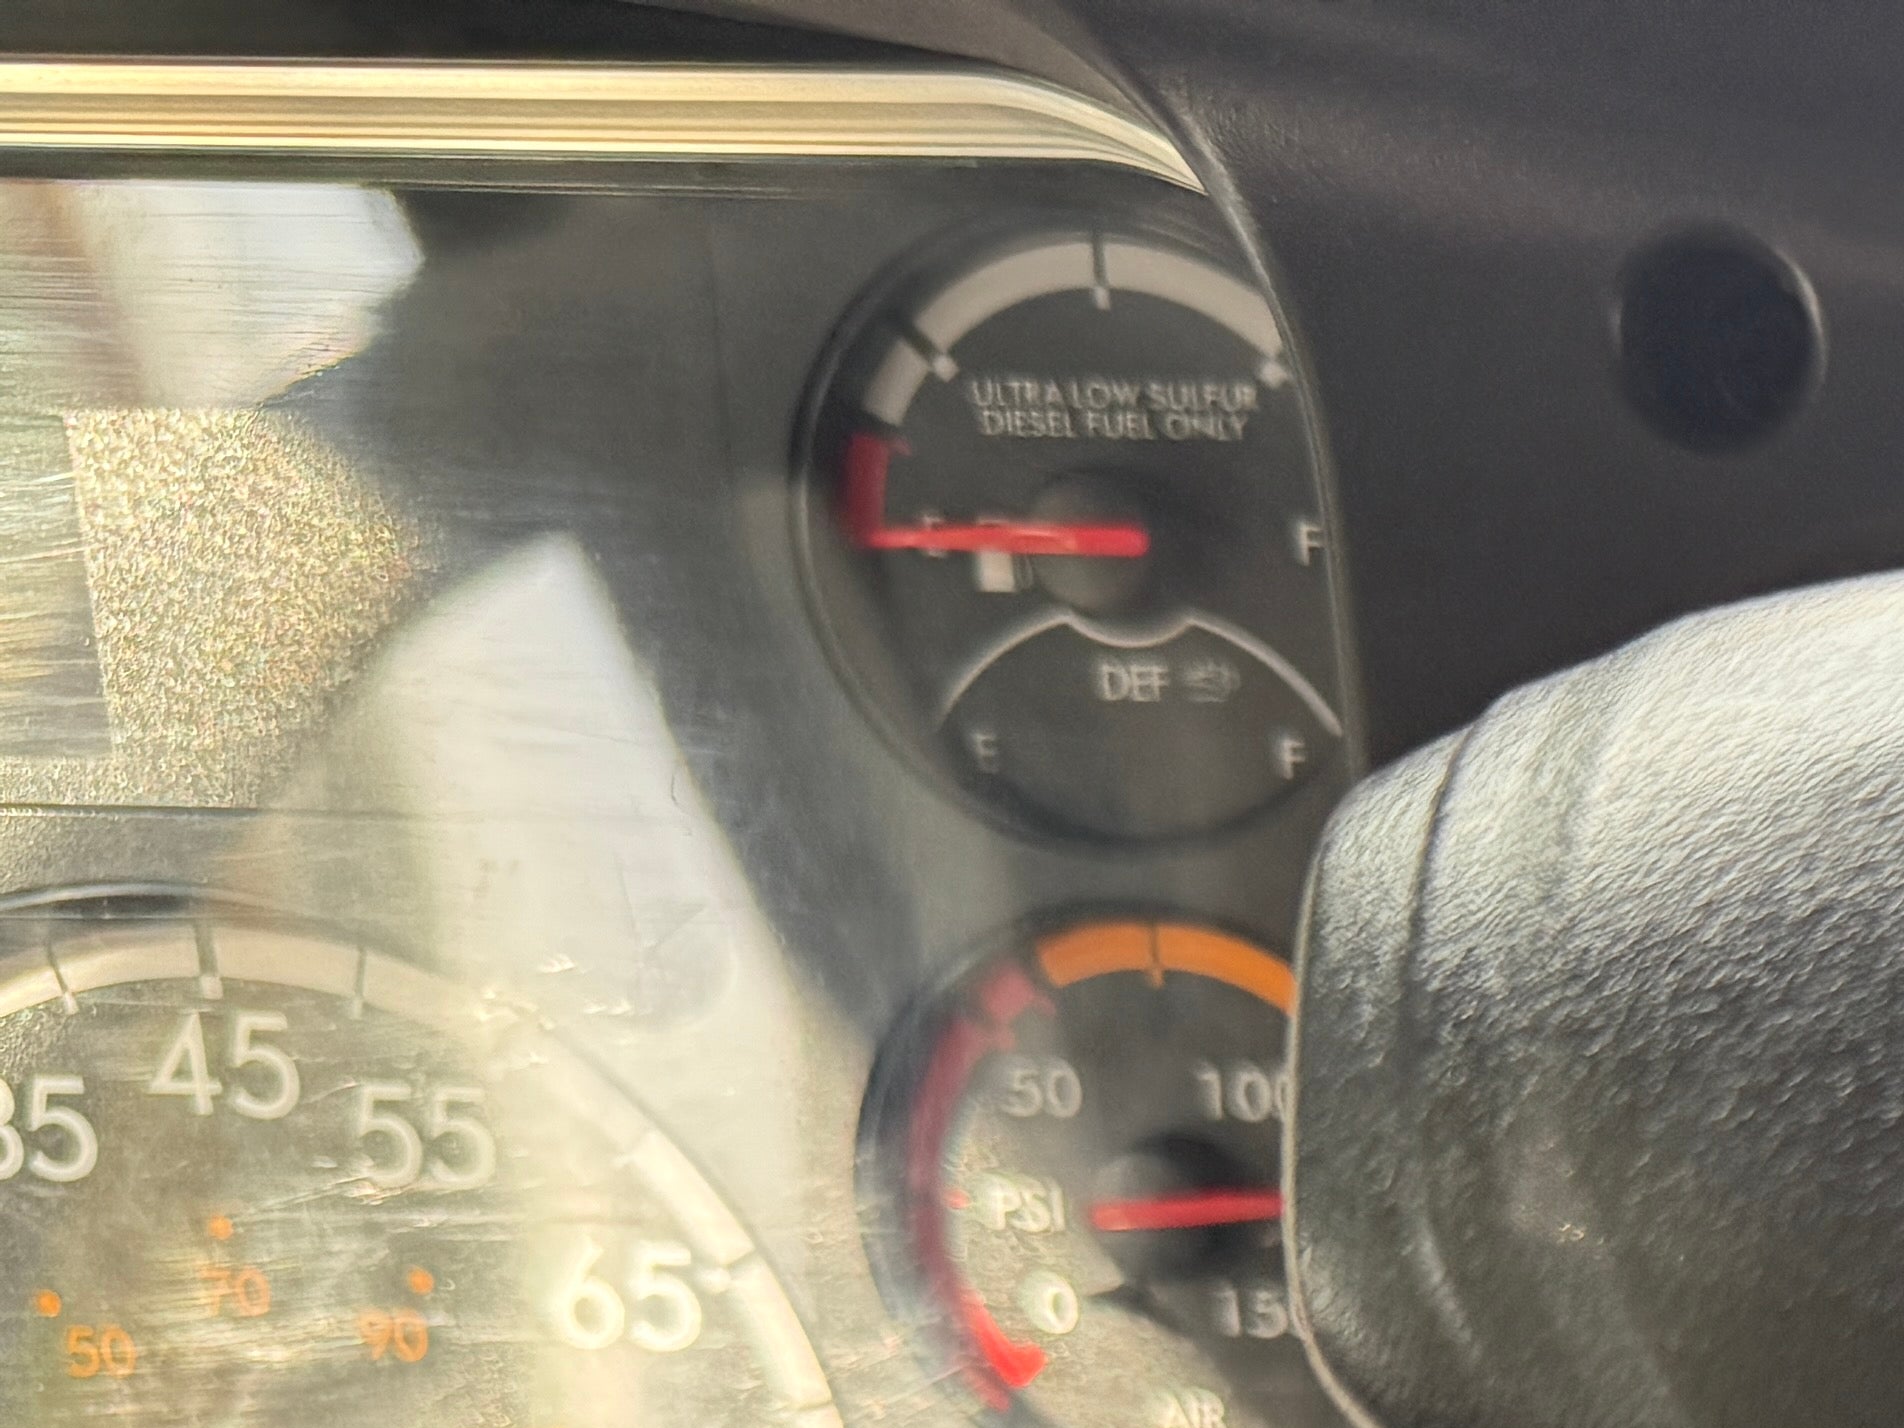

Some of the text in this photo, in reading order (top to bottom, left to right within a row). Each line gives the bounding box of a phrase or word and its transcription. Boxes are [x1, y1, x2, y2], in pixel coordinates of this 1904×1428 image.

[971, 379, 1258, 412] ULTRA LOW SULFUR
[980, 410, 1251, 441] DIESEL FUEL ONLY
[1297, 521, 1325, 566] F
[1101, 663, 1168, 701] DEF
[974, 733, 998, 774] E
[1280, 737, 1305, 780] F
[150, 1010, 299, 1121] 45
[1005, 1055, 1083, 1119] 50
[355, 1082, 497, 1192] 55
[994, 1174, 1064, 1233] PSI
[204, 1267, 270, 1318] 70
[550, 1241, 703, 1354] 65
[1030, 1272, 1078, 1335] 0
[66, 1324, 137, 1379] 50
[359, 1308, 430, 1363] 90
